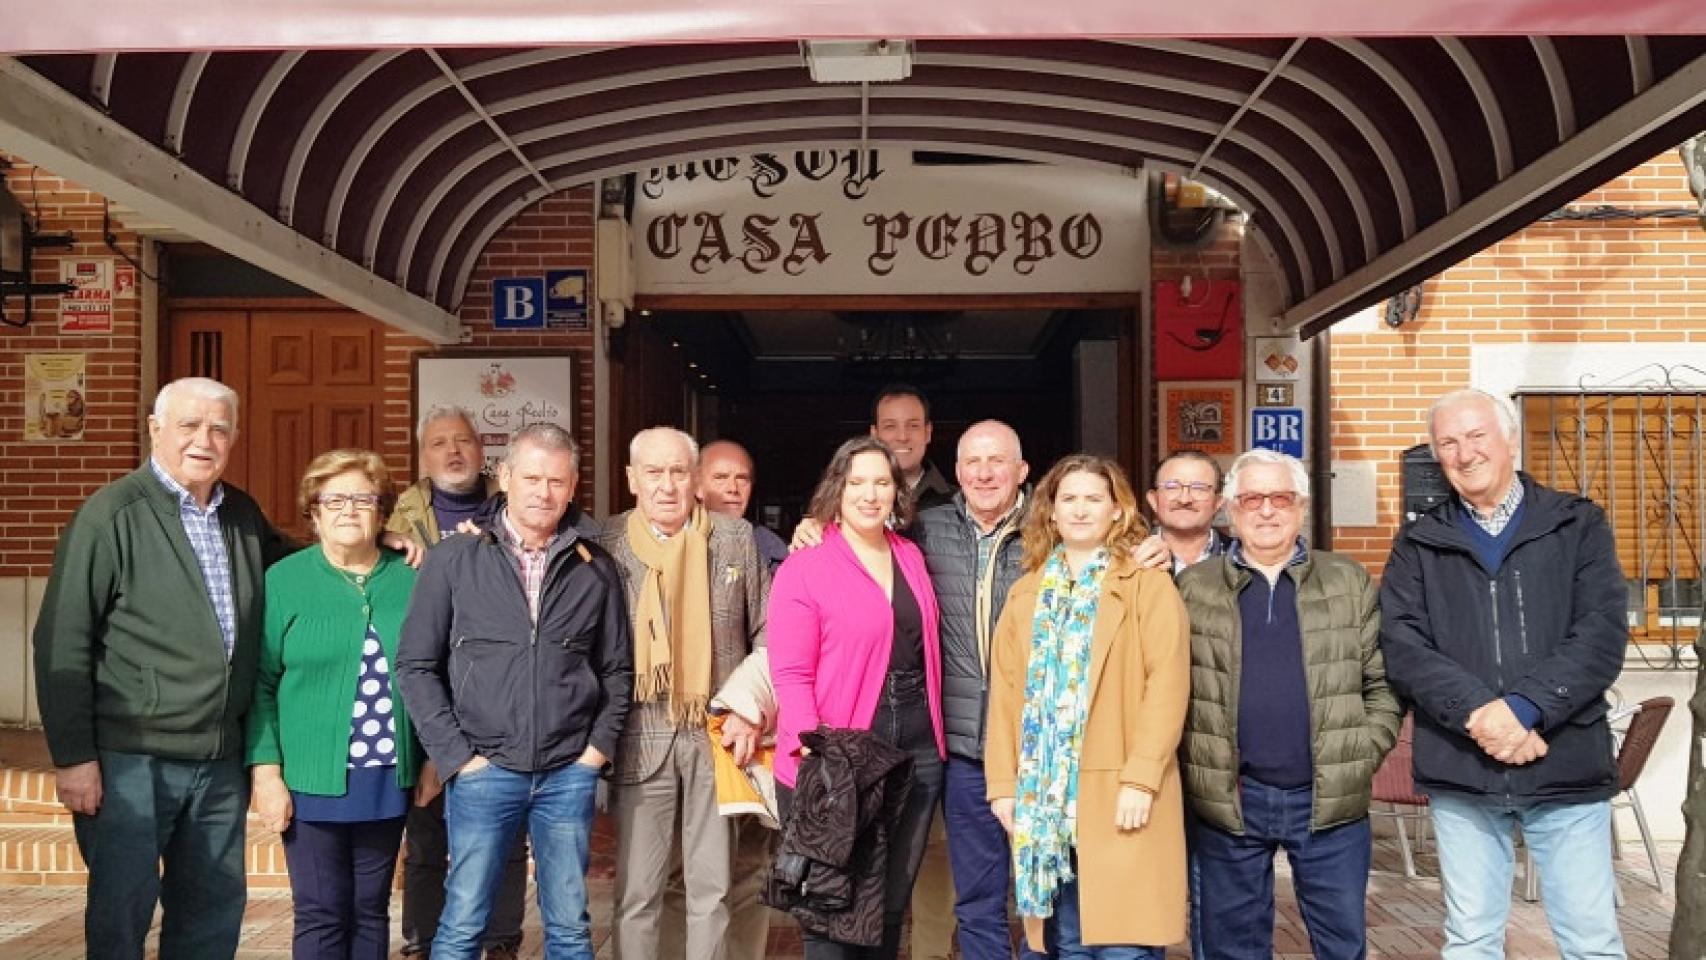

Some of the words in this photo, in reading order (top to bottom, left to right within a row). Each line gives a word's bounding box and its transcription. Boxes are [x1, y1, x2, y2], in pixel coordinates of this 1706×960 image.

[646, 211, 831, 277] CASA
[863, 210, 1104, 277] PEDRO
[503, 286, 535, 320] B
[1256, 414, 1300, 440] BR
